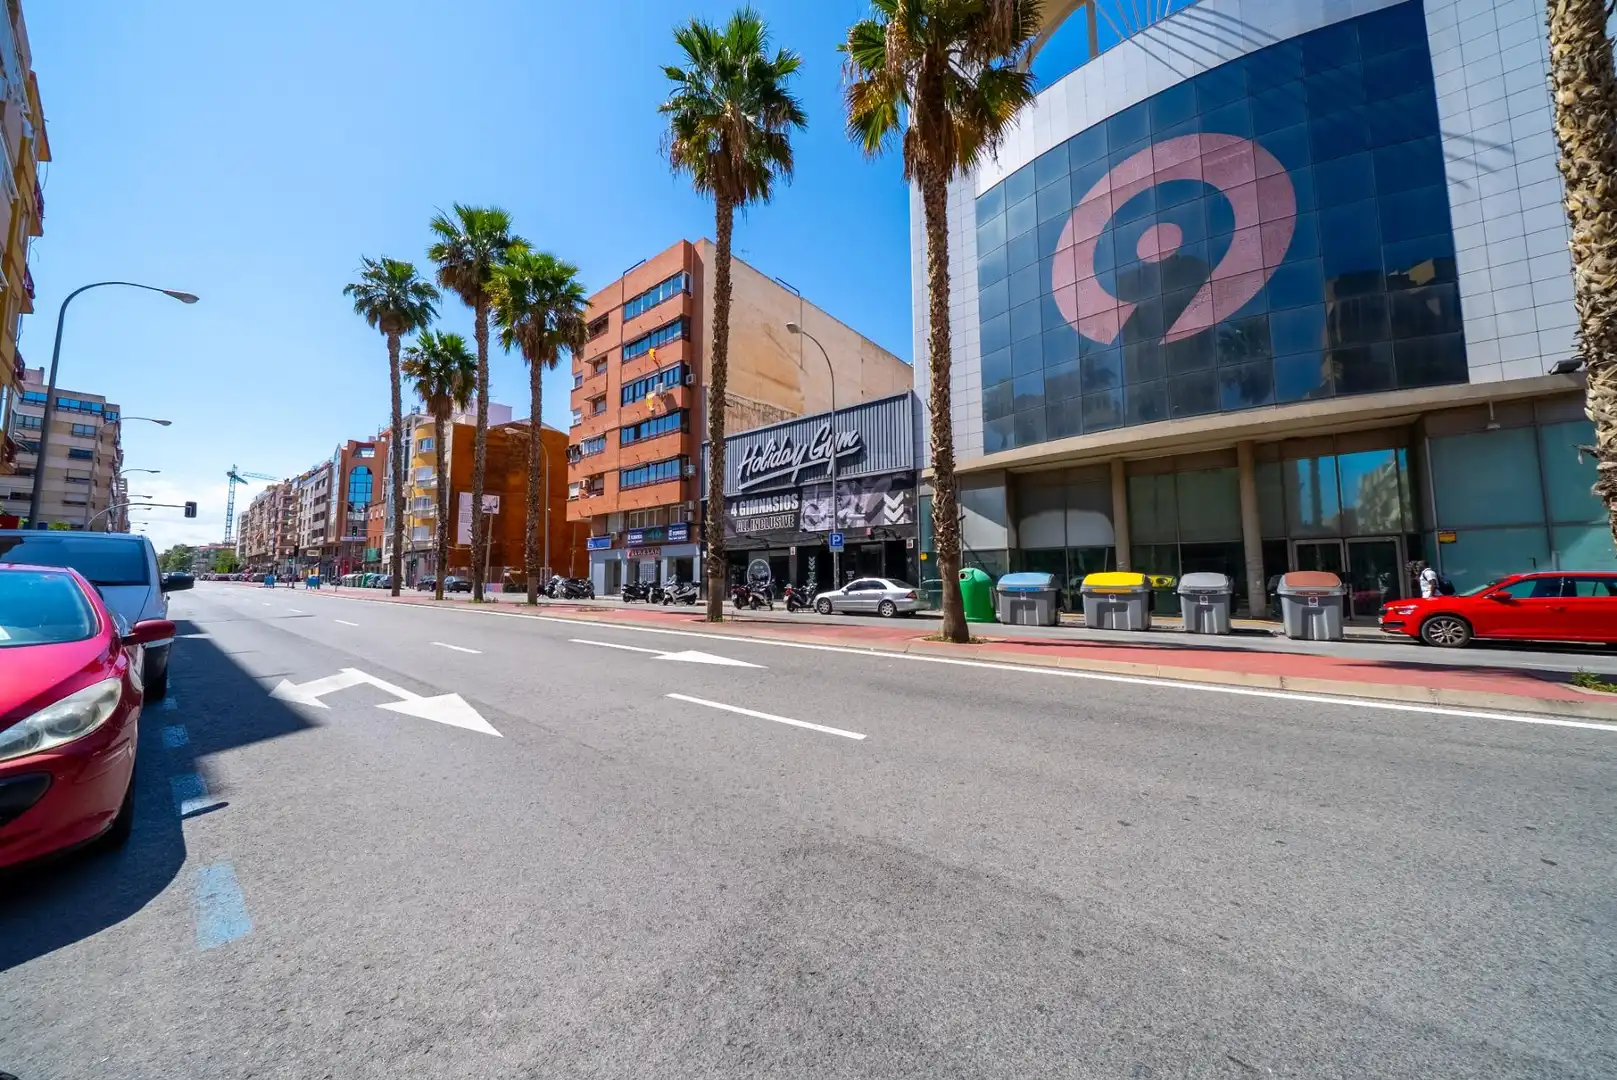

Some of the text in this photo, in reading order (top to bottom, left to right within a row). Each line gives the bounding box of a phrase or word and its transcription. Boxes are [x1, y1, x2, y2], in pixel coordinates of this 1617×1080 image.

[737, 421, 860, 482] Holiday Gym
[731, 493, 799, 517] 4 GIMNASIOS
[736, 514, 795, 533] ALL INCLUSIVE
[832, 534, 841, 546] P
